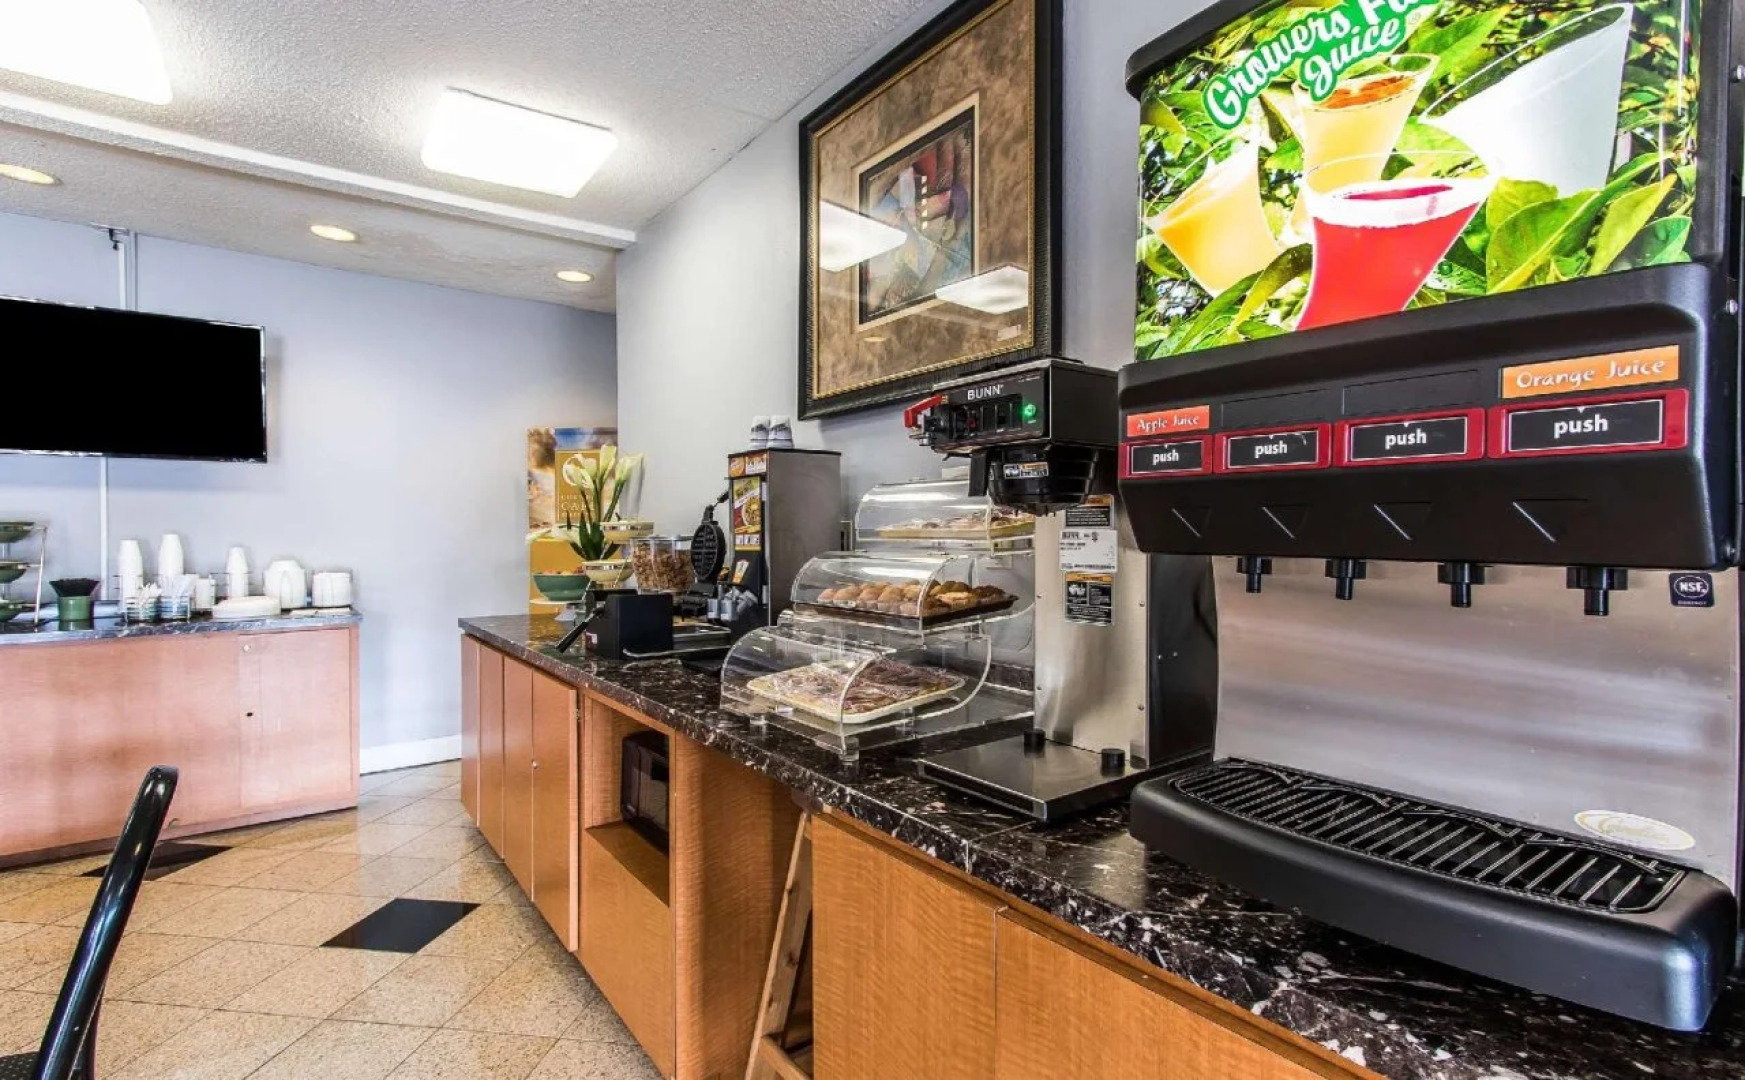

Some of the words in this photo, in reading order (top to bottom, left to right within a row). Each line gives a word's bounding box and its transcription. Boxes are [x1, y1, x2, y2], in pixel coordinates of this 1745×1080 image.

[1206, 10, 1351, 125] Growers
[1304, 17, 1401, 98] Juice
[1516, 366, 1596, 390] Orange
[1605, 356, 1667, 378] Juice
[967, 384, 1001, 401] BUNN
[1136, 417, 1168, 433] Apple
[1173, 414, 1200, 427] Juice
[1553, 413, 1609, 440] push
[1385, 427, 1427, 450] push
[1152, 448, 1180, 466] push
[1254, 440, 1288, 459] push
[1680, 581, 1703, 593] NSF
